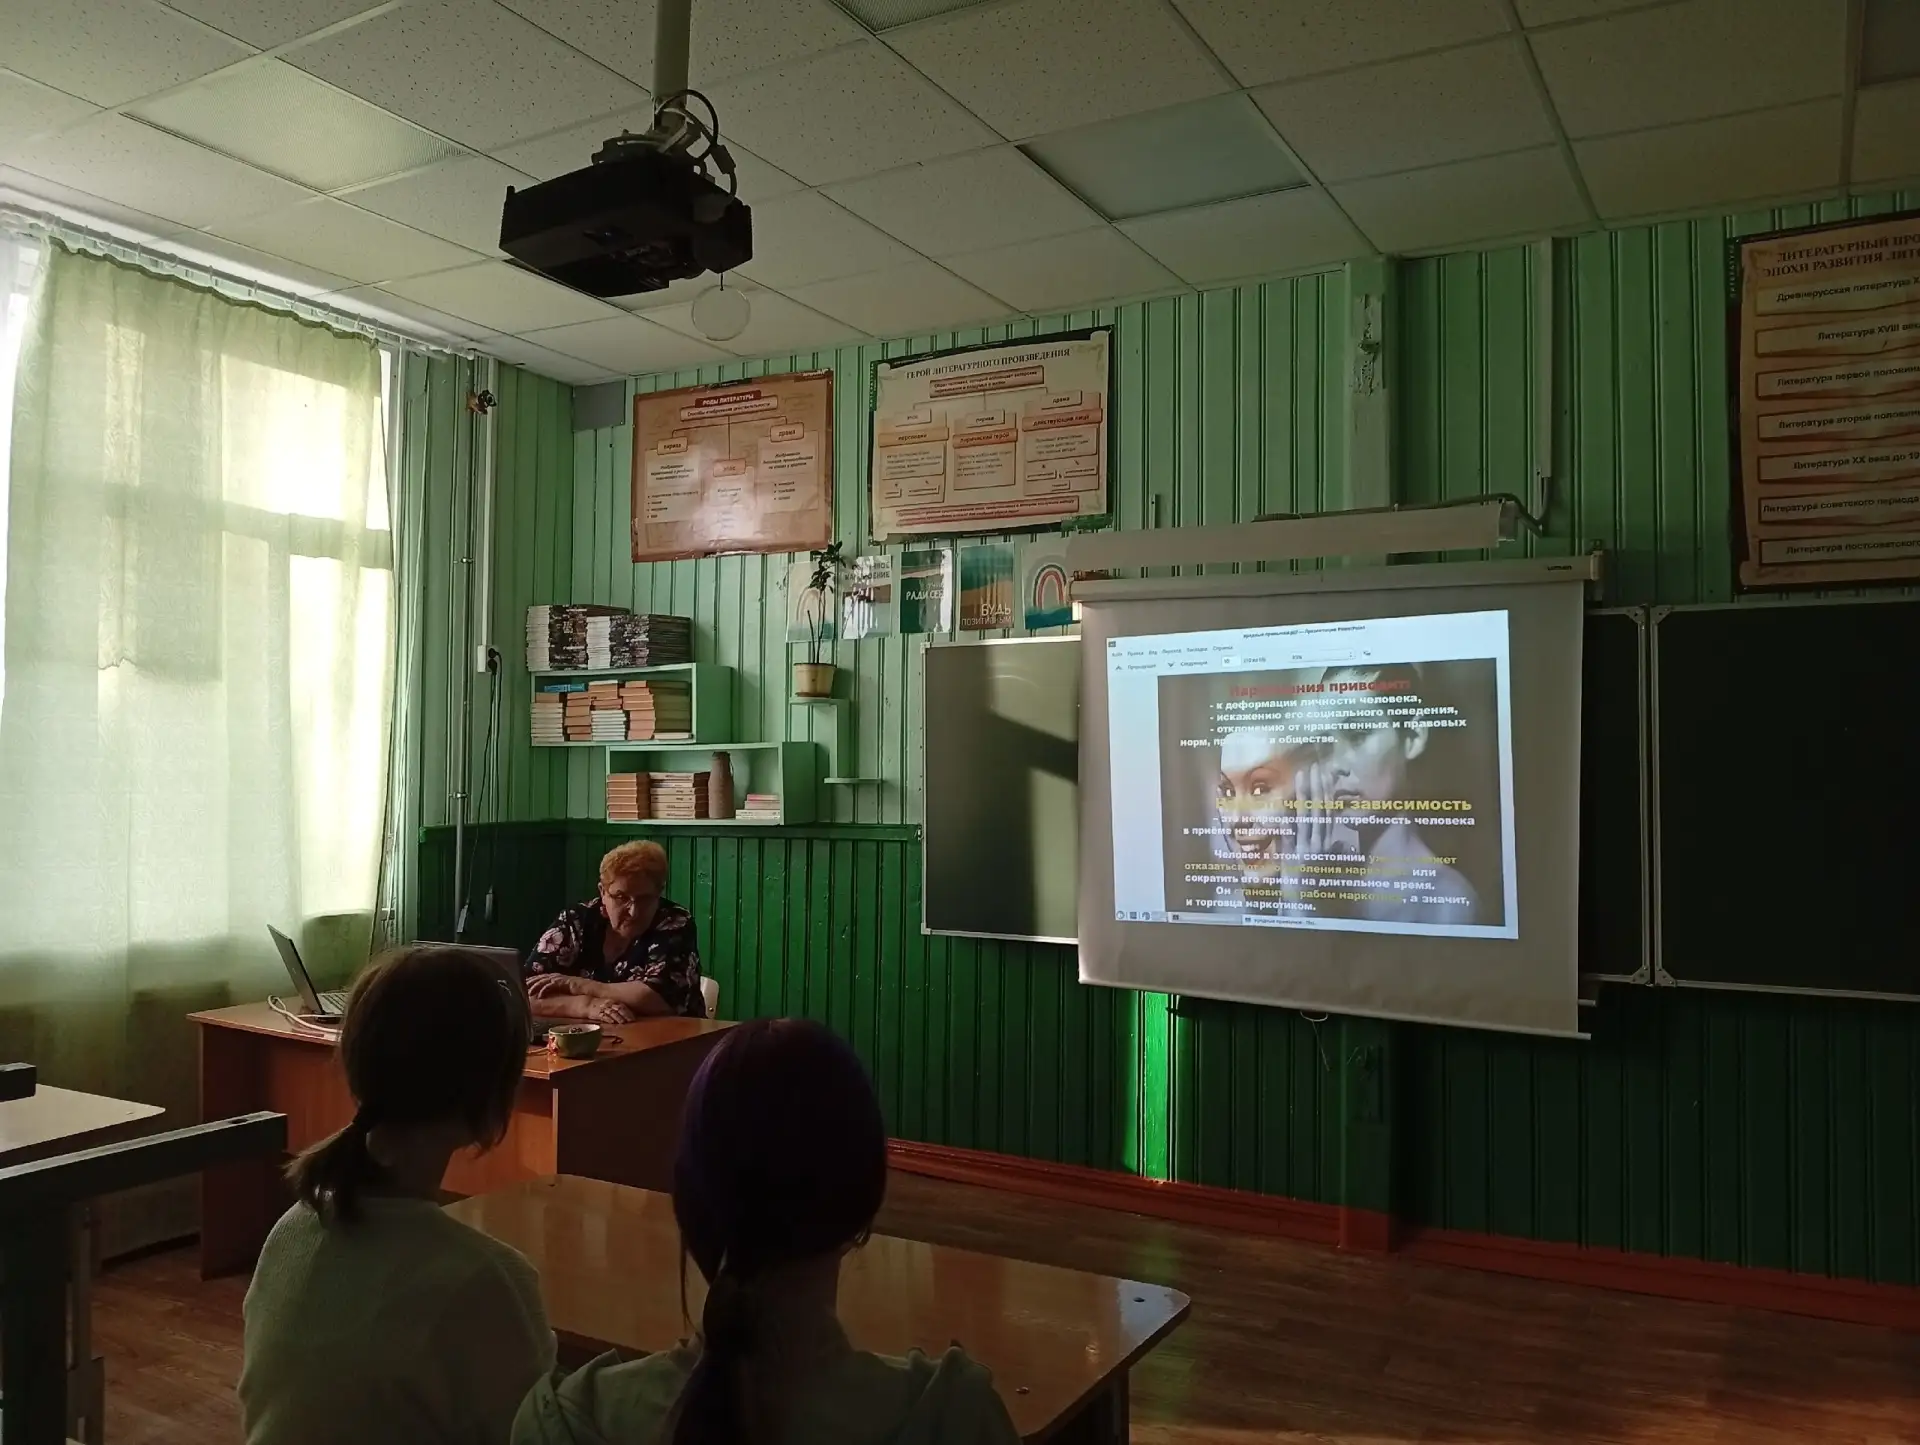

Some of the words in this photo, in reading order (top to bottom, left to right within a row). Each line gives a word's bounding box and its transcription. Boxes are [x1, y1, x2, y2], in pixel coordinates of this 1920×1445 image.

[1777, 236, 1889, 264] ЛИТЕРАТУРНЫЙ
[1763, 260, 1809, 278] ЭПОХИ
[1812, 252, 1883, 271] РАЗВИТИЯ
[1776, 285, 1851, 303] Древнерусская
[1853, 278, 1911, 292] литература
[1817, 328, 1875, 341] Литература
[1878, 323, 1900, 335] XVIII
[906, 366, 932, 379] ГЕРОЙ
[932, 357, 1000, 376] ЛИТЕРАТУРНОГО
[1001, 348, 1070, 366] ПРОИЗВЕДЕНИЯ
[1777, 374, 1833, 387] Литература
[1835, 370, 1871, 382] первой
[719, 394, 754, 404] ЛИТЕРАТУРЫ
[1778, 418, 1834, 430] Литература
[1836, 413, 1871, 424] второй
[1793, 458, 1850, 470] Литература
[1763, 501, 1818, 513] Литература
[1820, 498, 1875, 509] советского
[1877, 496, 1919, 506] периода
[1786, 543, 1842, 555] Литература
[981, 602, 1011, 616] БУДЬ
[1225, 699, 1297, 711] деформации
[1300, 696, 1356, 706] личности
[1359, 694, 1422, 705] человека,
[1216, 711, 1282, 722] искажению
[1306, 707, 1383, 720] социального
[1387, 706, 1458, 718] поведения,
[1288, 723, 1301, 731] от
[1303, 720, 1389, 732] нравственных
[1392, 721, 1401, 729] и
[1404, 719, 1467, 730] правовых
[1180, 737, 1211, 748] норм,
[1278, 735, 1338, 746] обществе.
[1350, 799, 1473, 811] зависимость
[1241, 815, 1332, 826] непреодолимая
[1335, 815, 1411, 827] потребность
[1414, 817, 1475, 826] человека
[1235, 827, 1296, 837] наркотика.
[1214, 849, 1260, 860] Человек
[1263, 852, 1270, 860] в
[1273, 852, 1300, 861] этом
[1303, 853, 1365, 862] состоянии
[1412, 868, 1436, 877] или
[1184, 874, 1239, 884] сократить
[1241, 876, 1260, 884] его
[1301, 877, 1316, 886] на
[1318, 878, 1390, 889] длительное
[1393, 882, 1436, 891] время.
[1216, 886, 1231, 895] Он
[1299, 888, 1336, 900] рабом
[1421, 895, 1470, 906] значит,
[1195, 898, 1242, 909] торговца
[1245, 901, 1316, 911] наркотиком.
